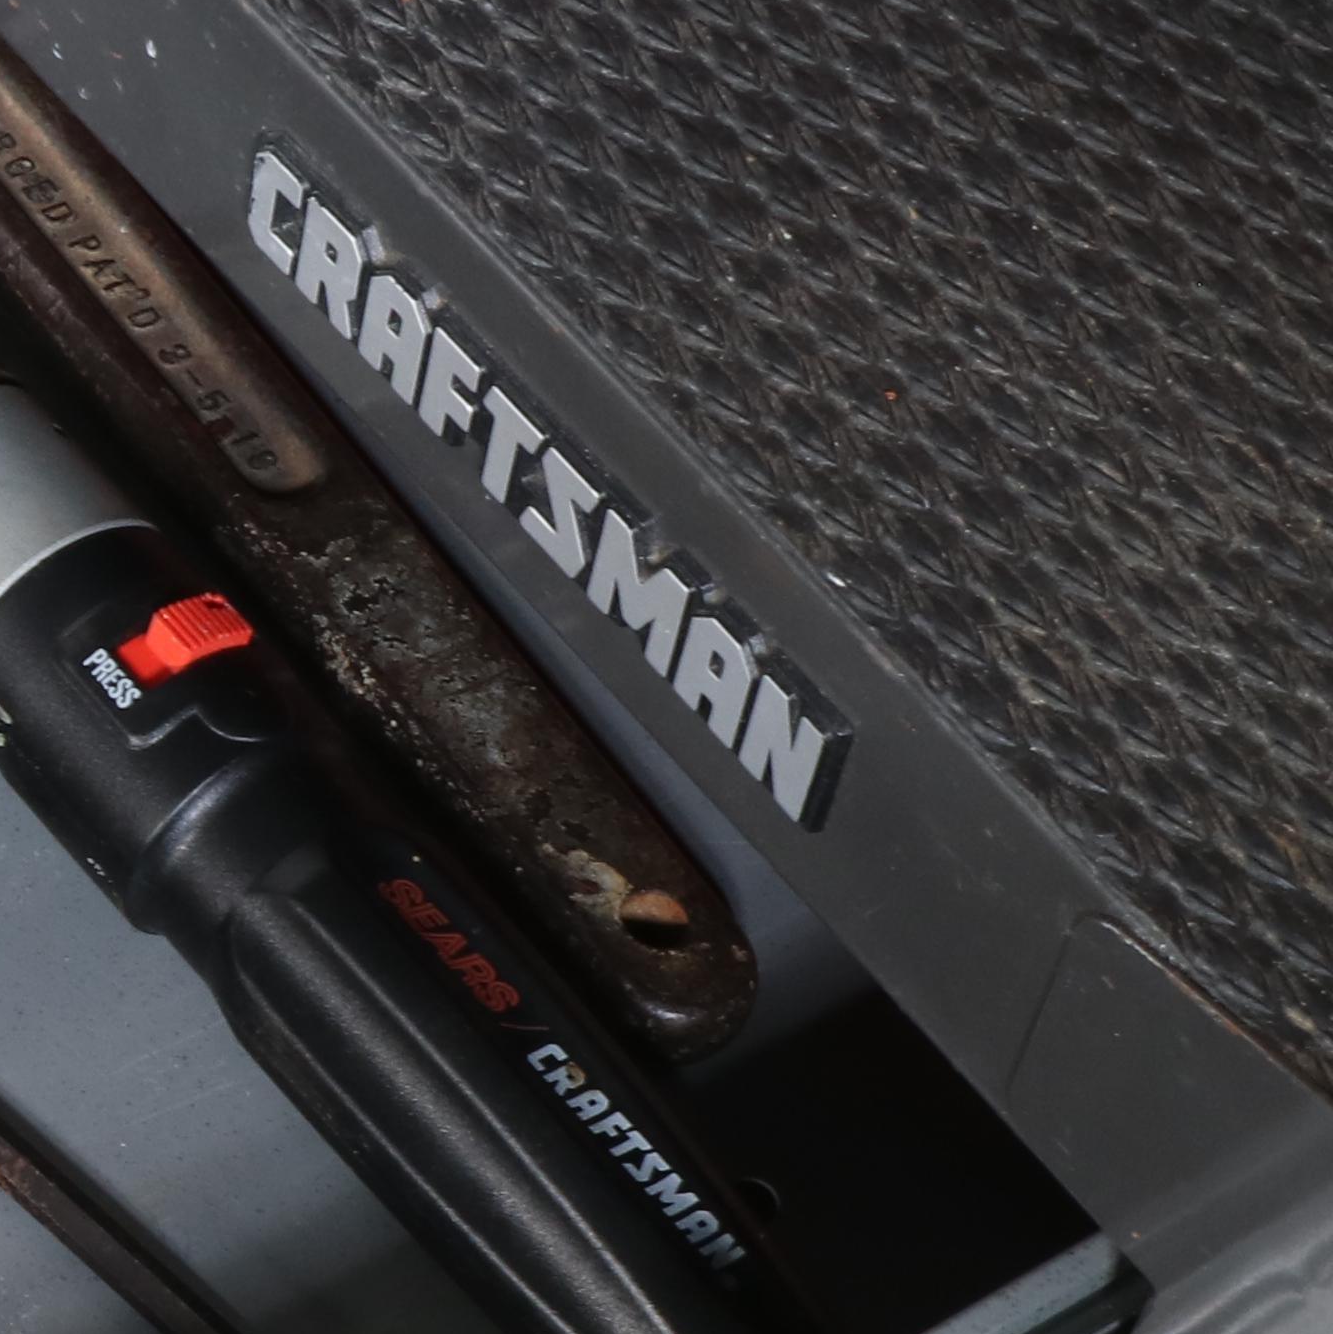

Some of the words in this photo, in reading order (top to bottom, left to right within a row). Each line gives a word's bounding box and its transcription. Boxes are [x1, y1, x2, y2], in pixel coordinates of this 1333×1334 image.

[81, 647, 143, 710] PRESS
[246, 149, 827, 823] CRAFTSMAN
[378, 878, 523, 1014] SEARS
[526, 1042, 746, 1271] CRAFTSMAN
